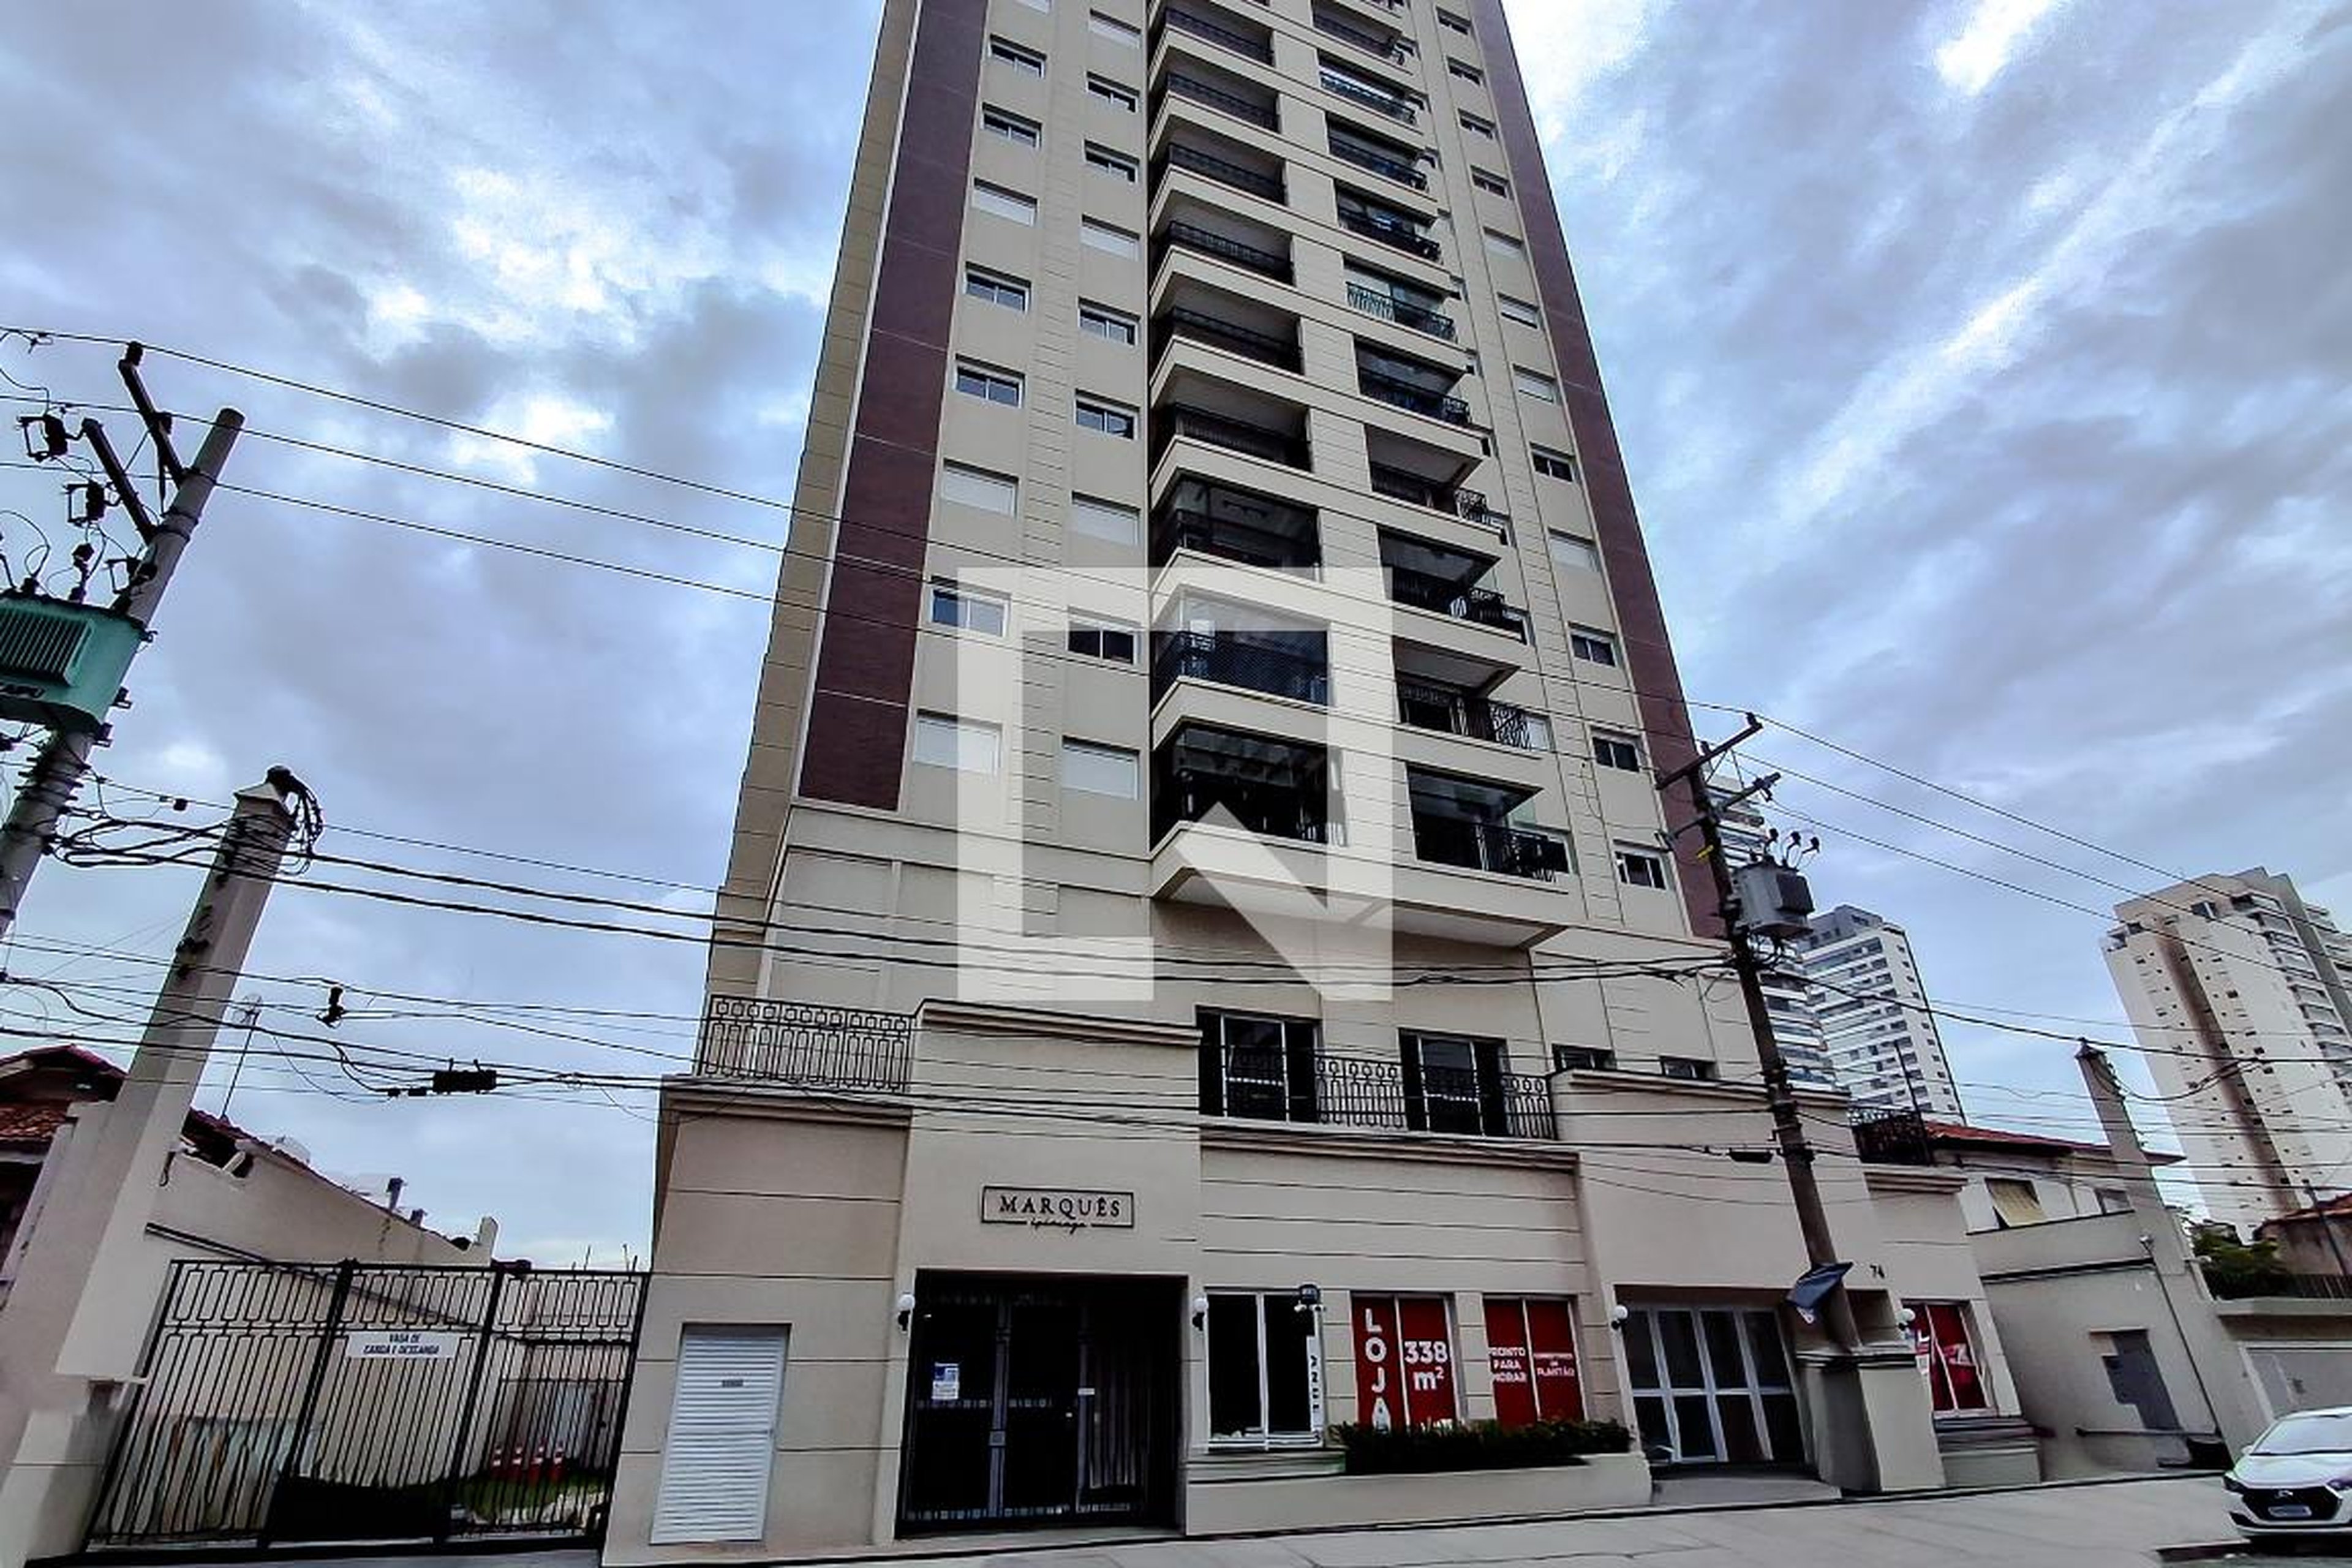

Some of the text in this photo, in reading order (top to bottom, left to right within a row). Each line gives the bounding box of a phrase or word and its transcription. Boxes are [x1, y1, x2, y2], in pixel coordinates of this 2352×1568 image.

[1000, 1196, 1120, 1219] MARQUÊS
[1404, 1341, 1448, 1364] 338
[1365, 1308, 1391, 1433] LOJA
[1493, 1360, 1521, 1370] PARA
